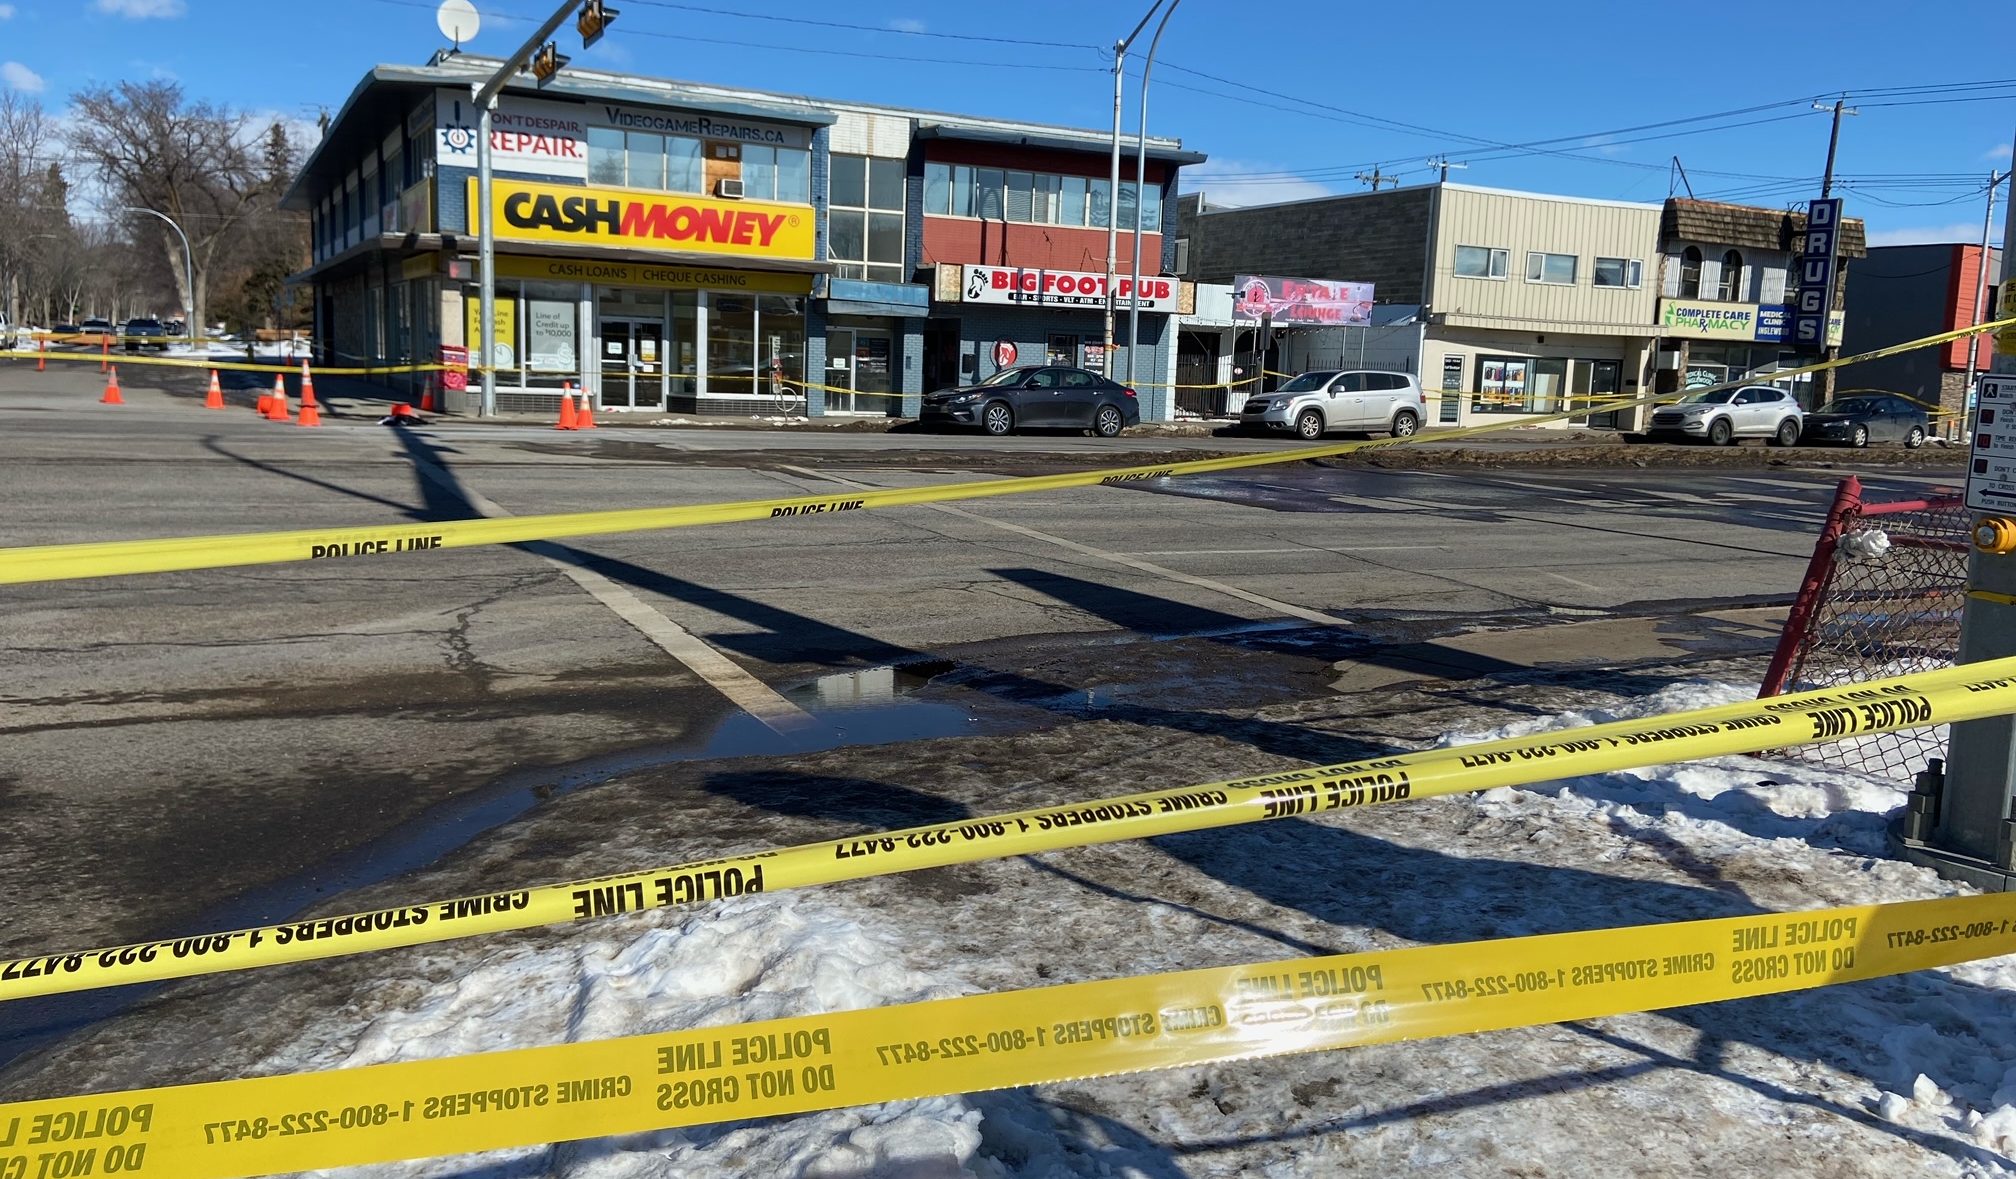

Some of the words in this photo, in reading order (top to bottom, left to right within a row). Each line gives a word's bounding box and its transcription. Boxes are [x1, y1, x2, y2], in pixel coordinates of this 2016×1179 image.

[491, 113, 526, 126] ON'T
[549, 264, 583, 277] CASH
[587, 266, 627, 279] LOANS
[643, 270, 691, 283] CHEQUE
[694, 273, 747, 286] CASHING
[992, 270, 1036, 292] BIG
[1119, 279, 1170, 299] PUB
[1798, 203, 1831, 340] DRUGS
[1014, 294, 1027, 302] BAR
[536, 321, 559, 329] Credit
[561, 324, 569, 332] up
[554, 313, 561, 321] of
[1676, 307, 1721, 319] COMPLETE
[1723, 311, 1751, 321] CARE
[1760, 310, 1792, 319] MEDICAL
[770, 503, 826, 518] POLICE
[829, 500, 865, 512] LINE
[311, 540, 389, 559] POLICE
[395, 536, 443, 553] LINE
[1805, 707, 1858, 739] LINE
[1858, 695, 1932, 730] POLICE
[1263, 785, 1318, 819] LINE
[1327, 771, 1411, 809] POLICE
[654, 863, 764, 907] POLICE
[439, 889, 530, 921] CRIME
[572, 882, 644, 920] LINE
[276, 905, 430, 945] STOPPERS
